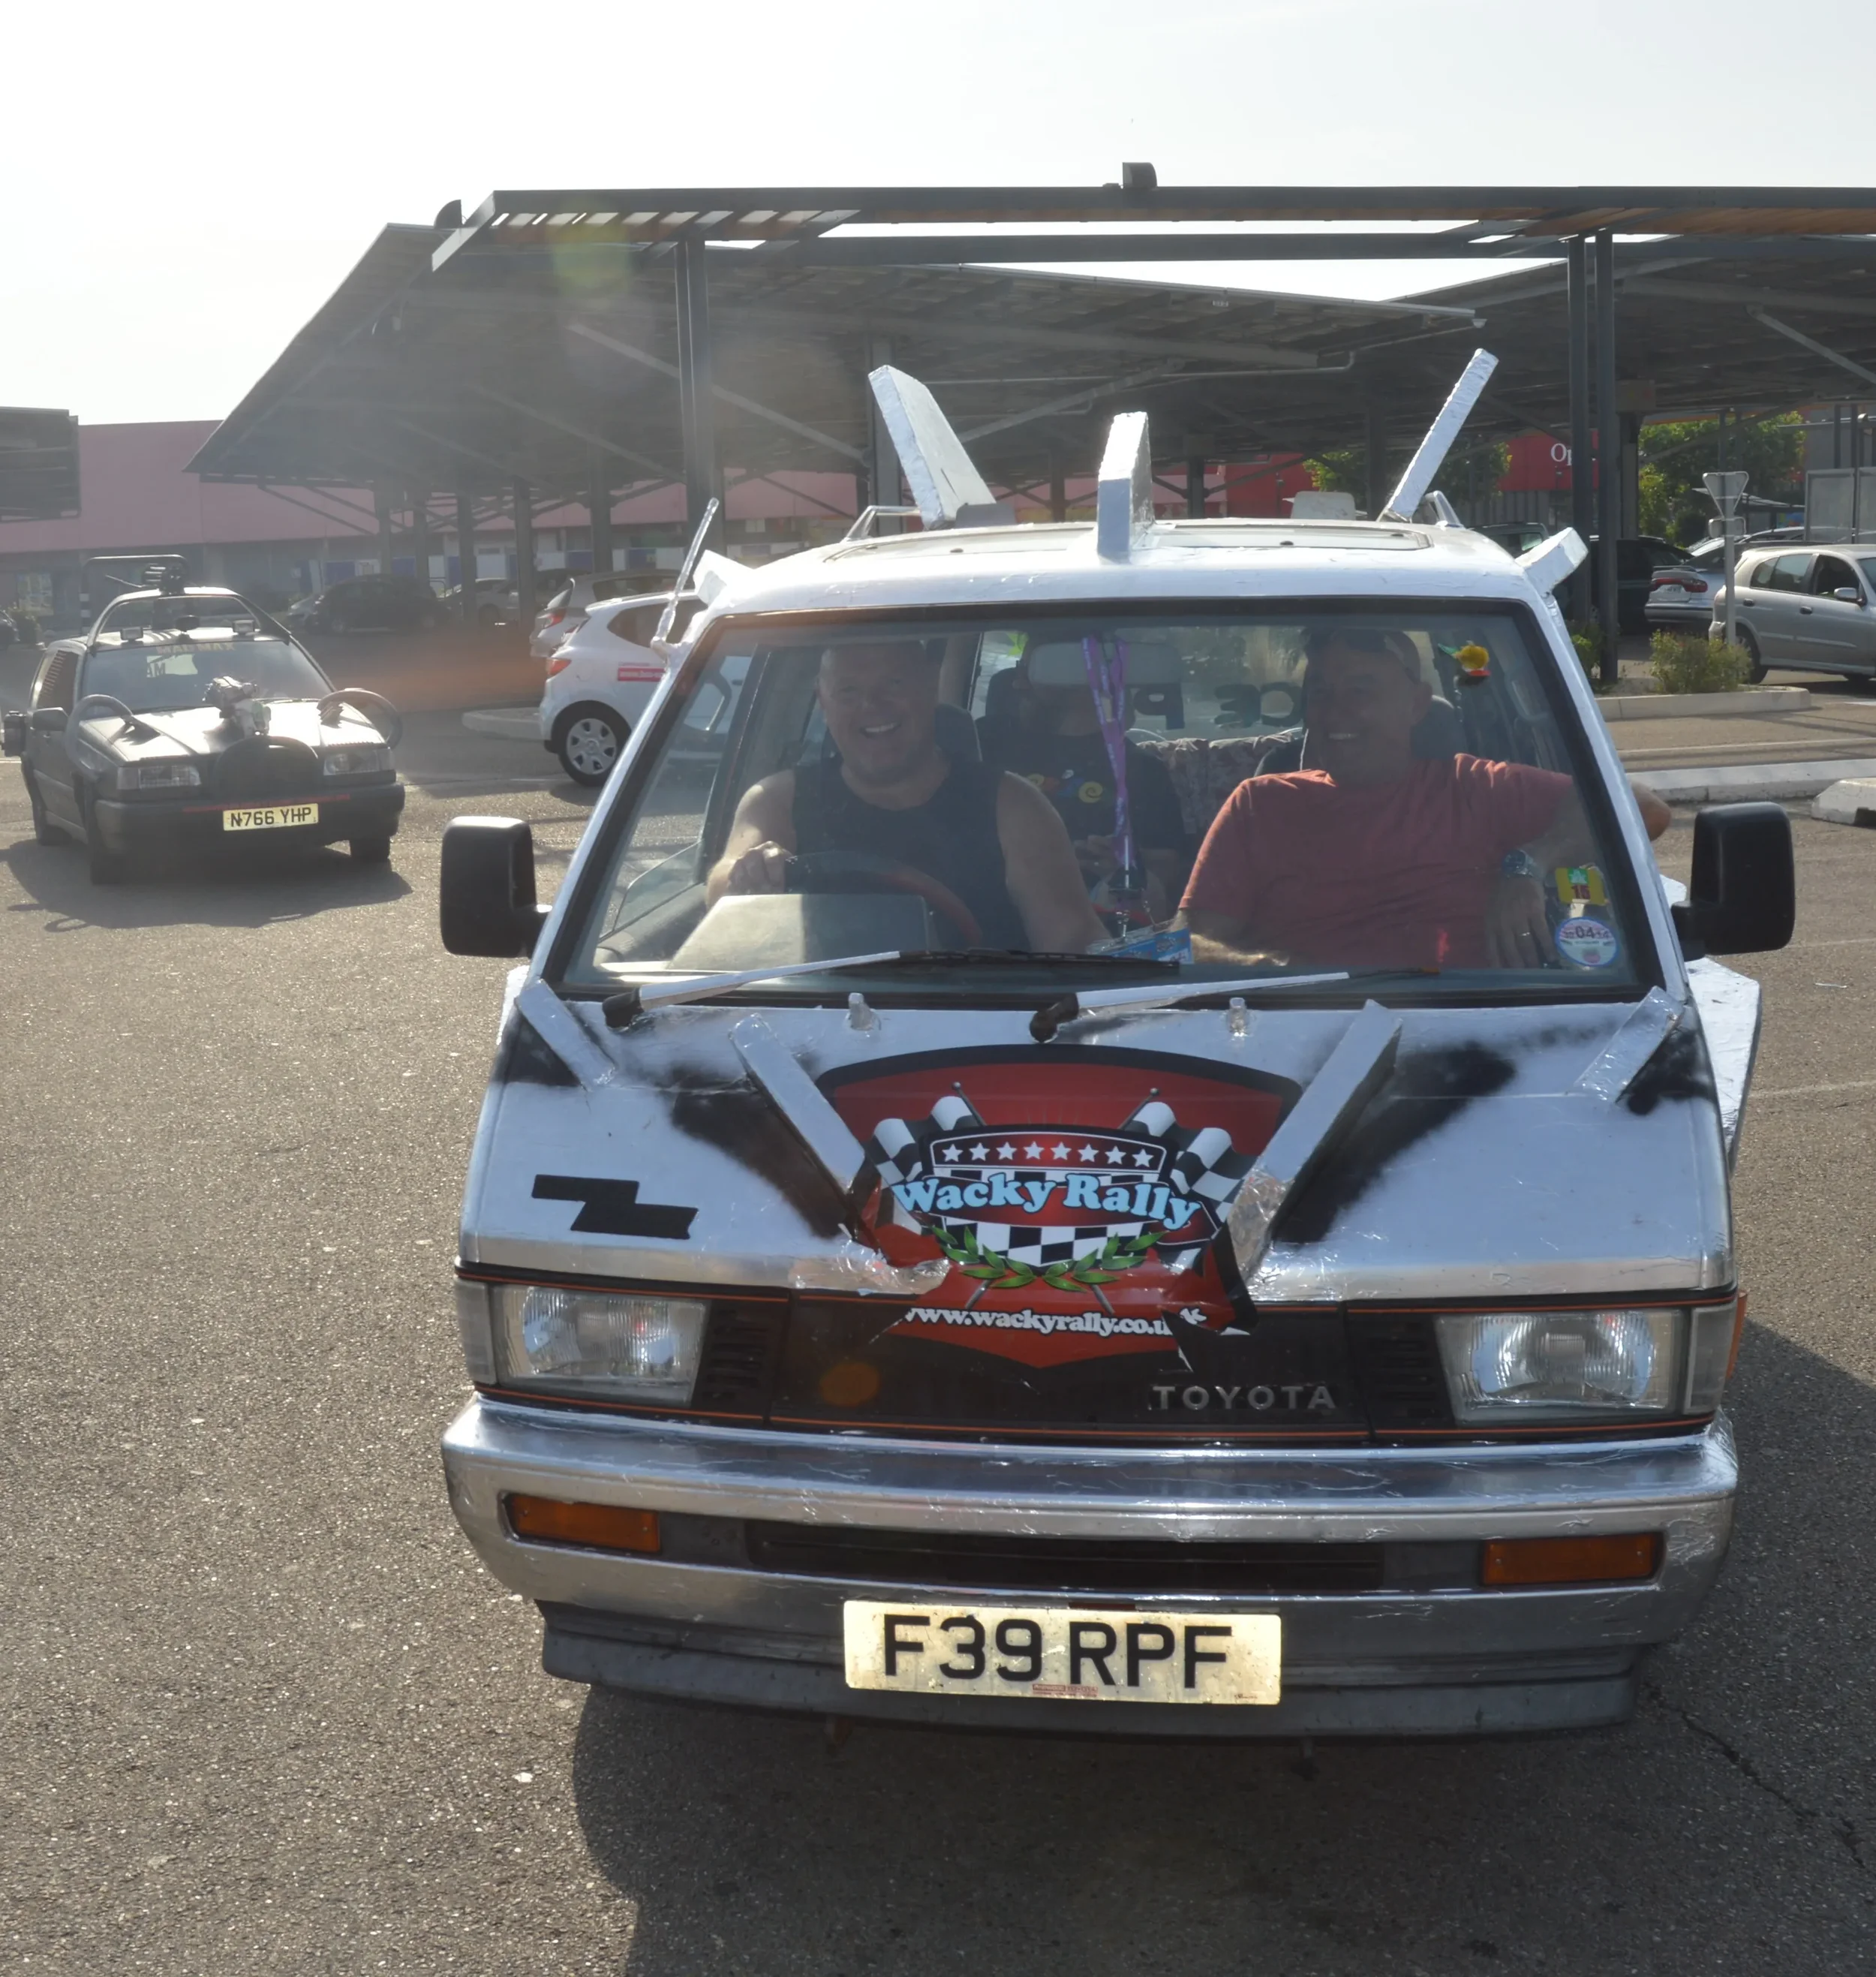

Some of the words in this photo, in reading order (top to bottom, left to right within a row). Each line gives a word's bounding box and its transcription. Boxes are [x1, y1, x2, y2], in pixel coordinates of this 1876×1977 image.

[230, 811, 275, 827] N766
[280, 807, 311, 823] YHP
[891, 1172, 1057, 1214] Wacky
[1064, 1172, 1201, 1230] Rally
[1152, 1386, 1336, 1410] TOYOTA
[883, 1614, 1042, 1682] F39
[1069, 1620, 1232, 1689] RPF
